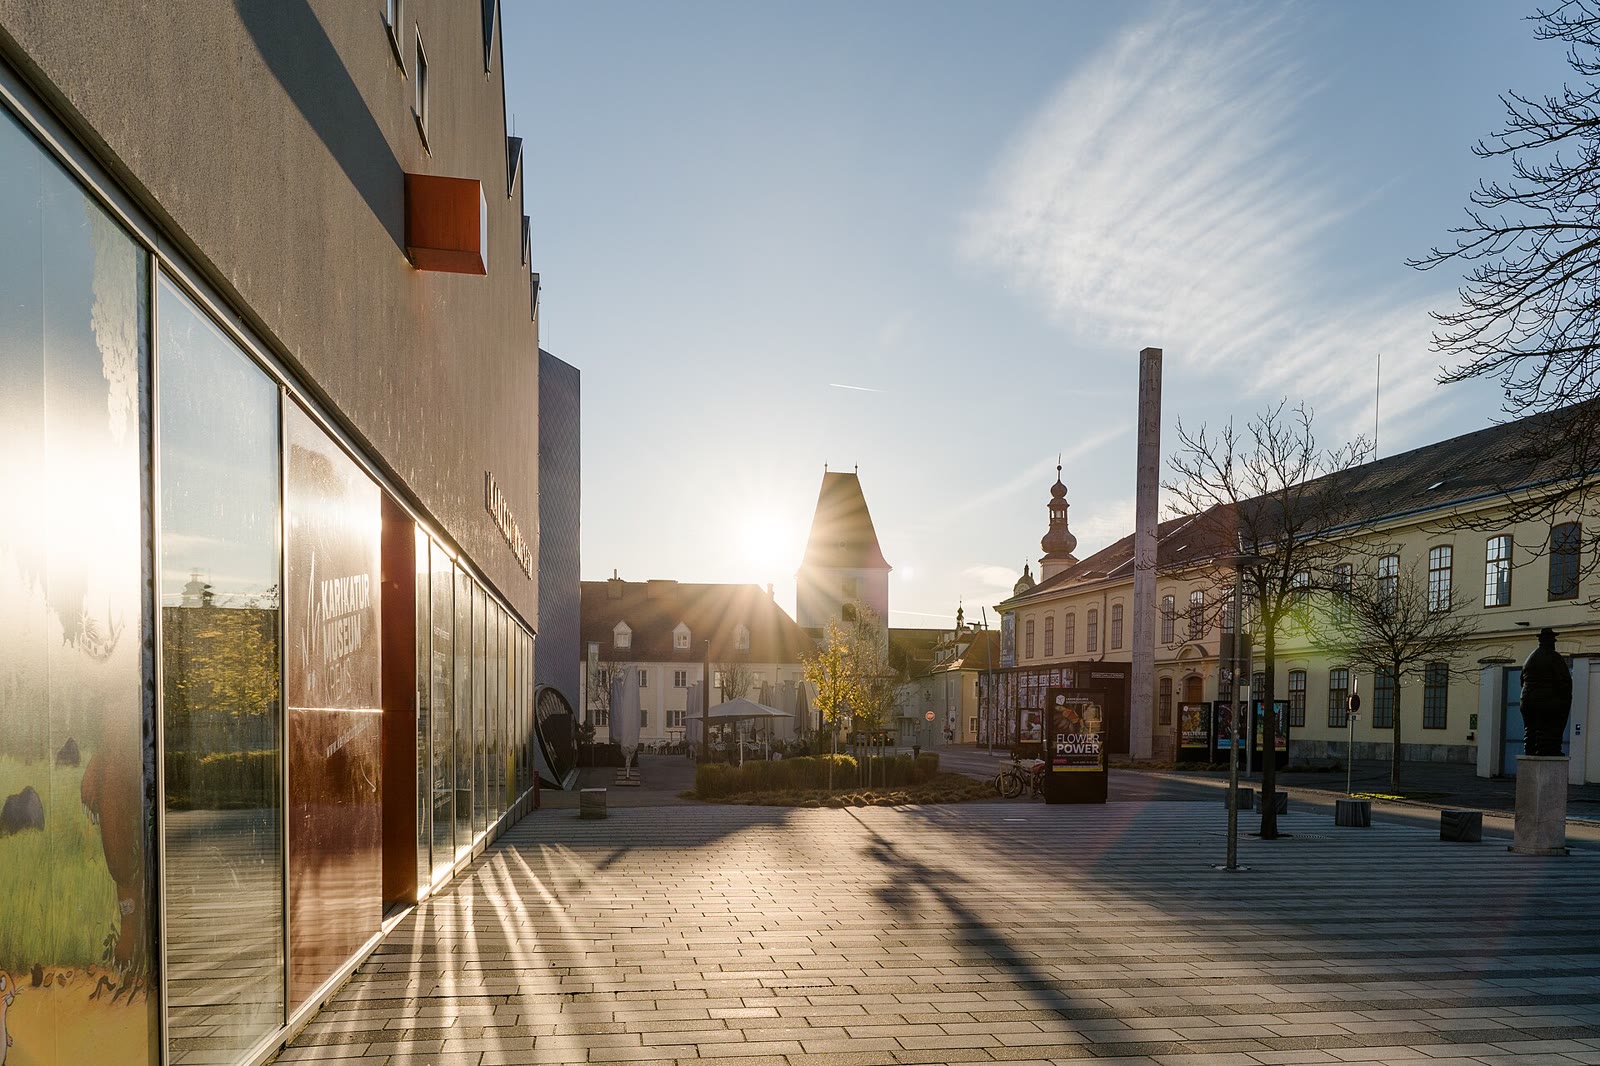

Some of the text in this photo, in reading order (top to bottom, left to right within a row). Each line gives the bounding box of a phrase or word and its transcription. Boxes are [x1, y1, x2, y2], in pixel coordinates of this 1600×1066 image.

[321, 574, 370, 621] KARIKATUR
[323, 613, 362, 664] MUSEUM
[1056, 734, 1100, 744] FLOWER
[1056, 744, 1100, 753] POWER
